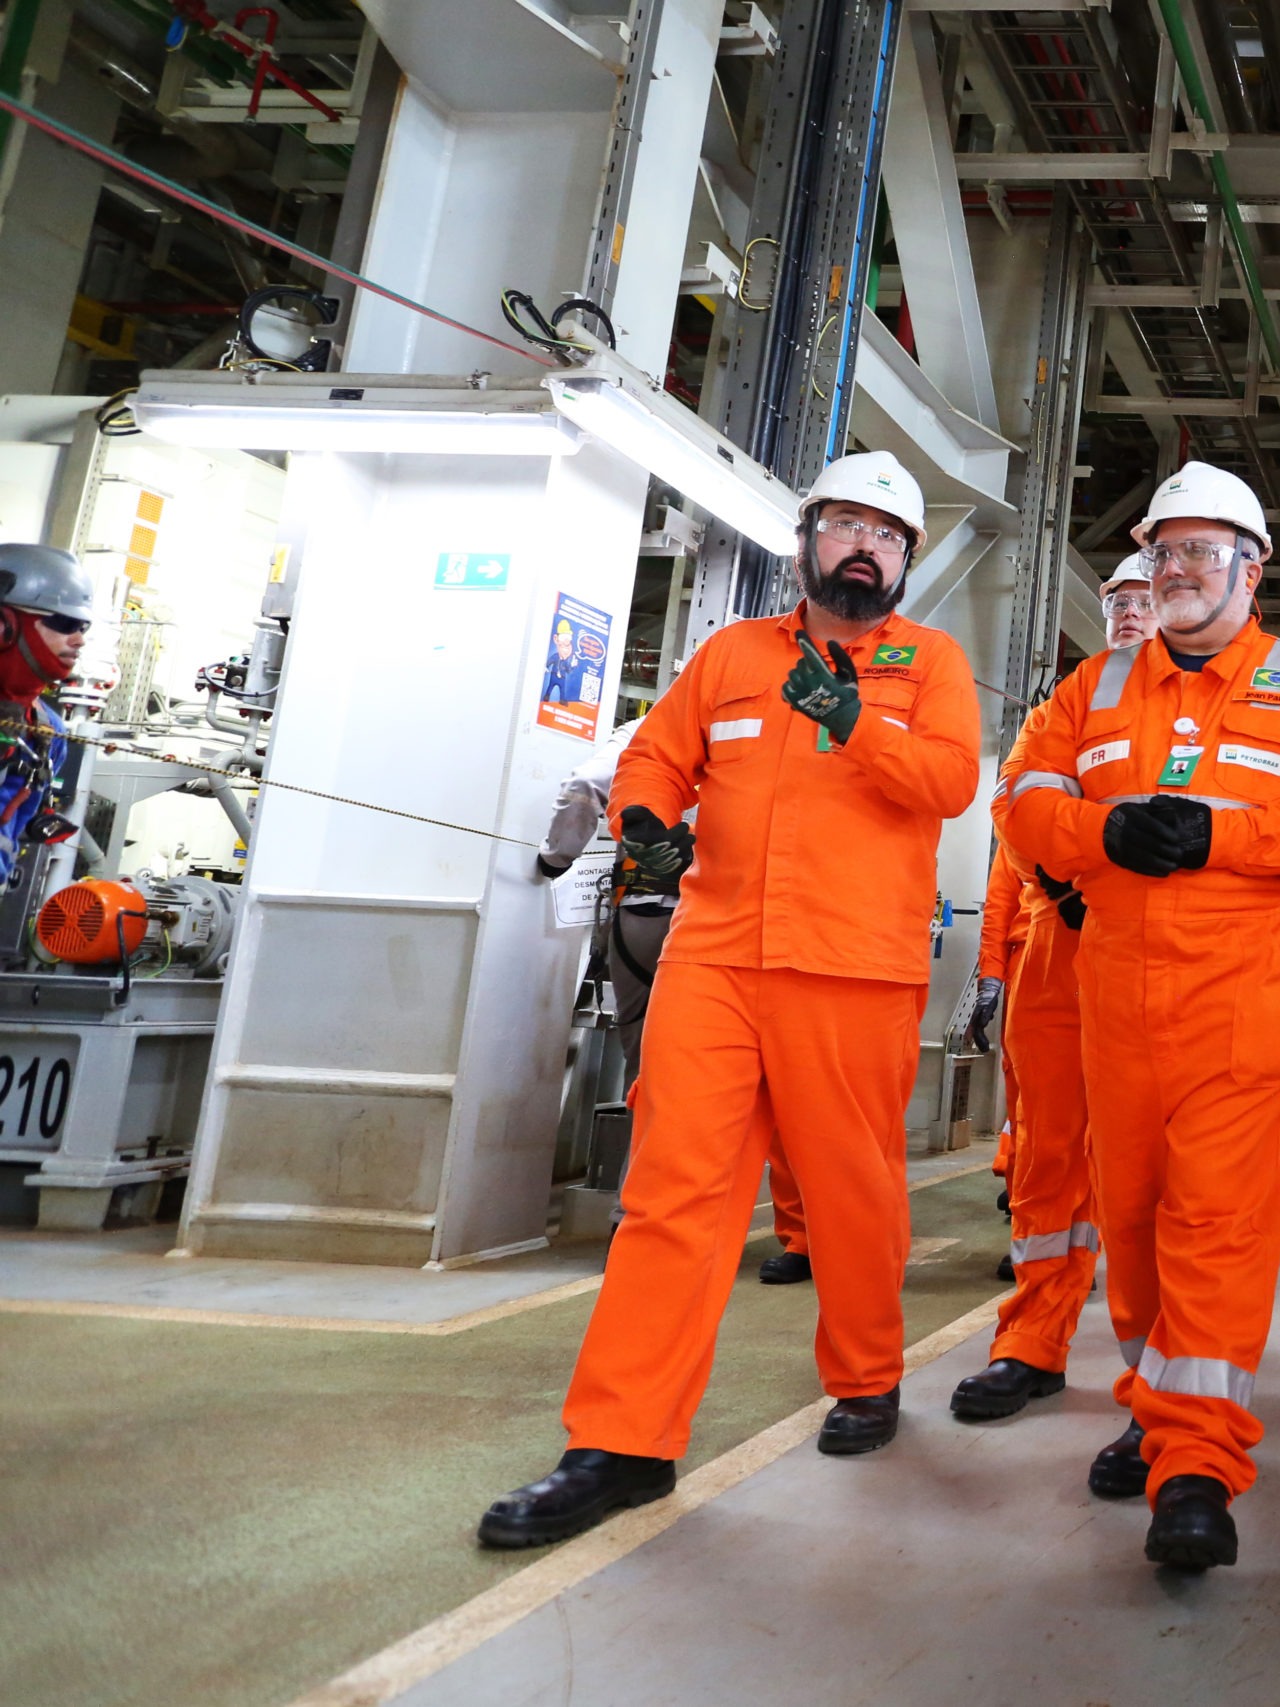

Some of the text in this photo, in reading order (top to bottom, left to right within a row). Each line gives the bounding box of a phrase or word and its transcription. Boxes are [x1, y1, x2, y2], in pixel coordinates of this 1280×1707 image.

[863, 667, 910, 676] ROMEIRO
[1091, 749, 1106, 765] FR
[1240, 754, 1279, 768] PETROBRAS
[574, 879, 612, 889] DESMNT
